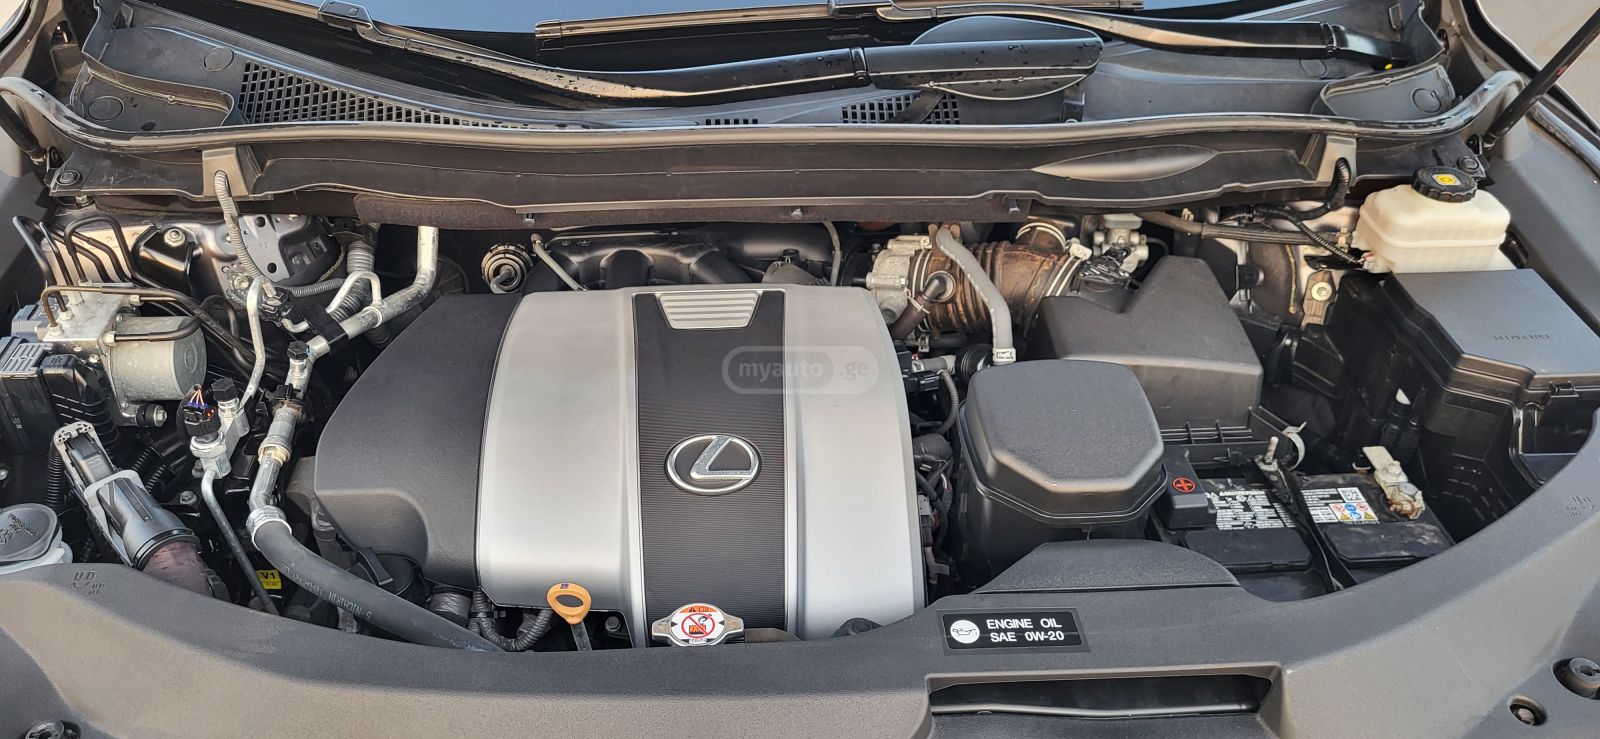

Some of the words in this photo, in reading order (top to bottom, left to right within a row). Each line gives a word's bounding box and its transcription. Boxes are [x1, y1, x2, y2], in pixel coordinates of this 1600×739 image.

[986, 618, 1033, 630] ENGINE
[1040, 617, 1062, 629] OIL
[990, 632, 1017, 643] SAE
[1025, 631, 1065, 642] 0W-20
